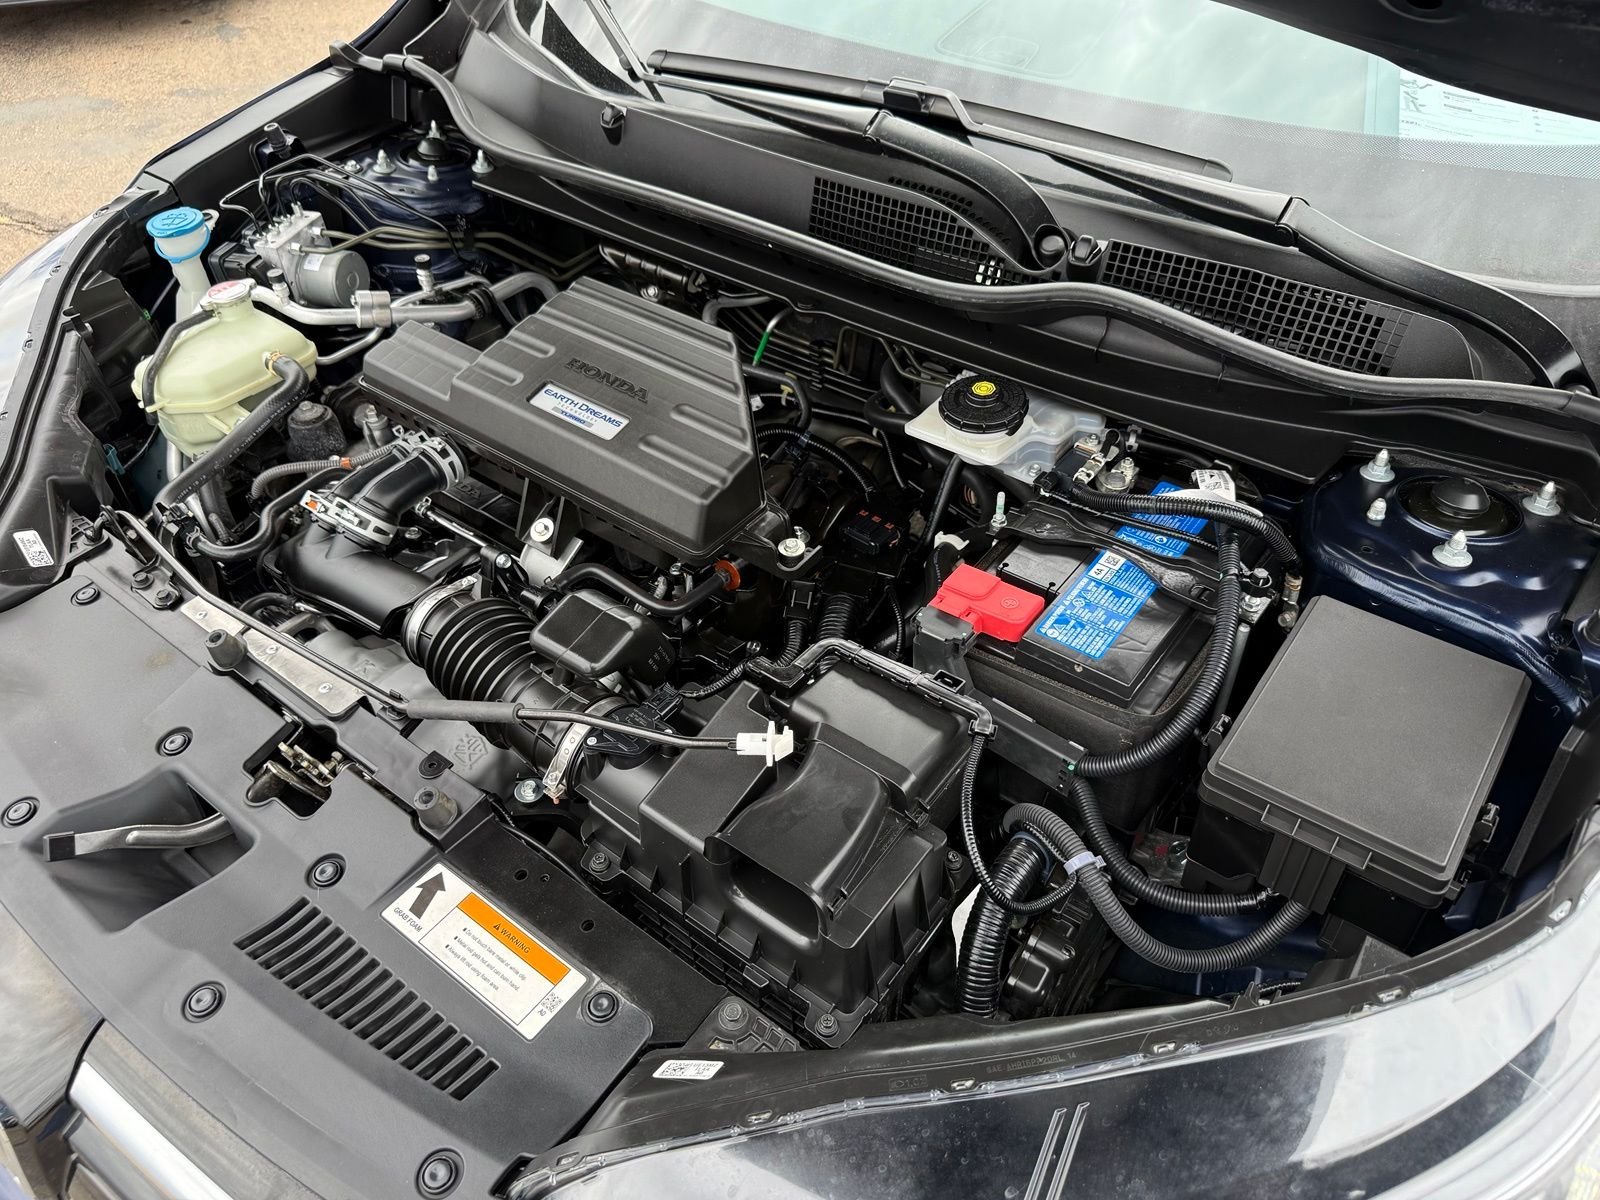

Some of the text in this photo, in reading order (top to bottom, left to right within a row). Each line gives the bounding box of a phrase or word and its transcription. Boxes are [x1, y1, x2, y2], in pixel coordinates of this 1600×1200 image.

[564, 358, 648, 404] HONDA
[544, 388, 623, 428] EARTH DREAMS
[560, 409, 586, 425] TURBO
[1094, 568, 1105, 576] 4A
[394, 907, 423, 932] GRAB FOAM
[500, 927, 530, 954] WARNING
